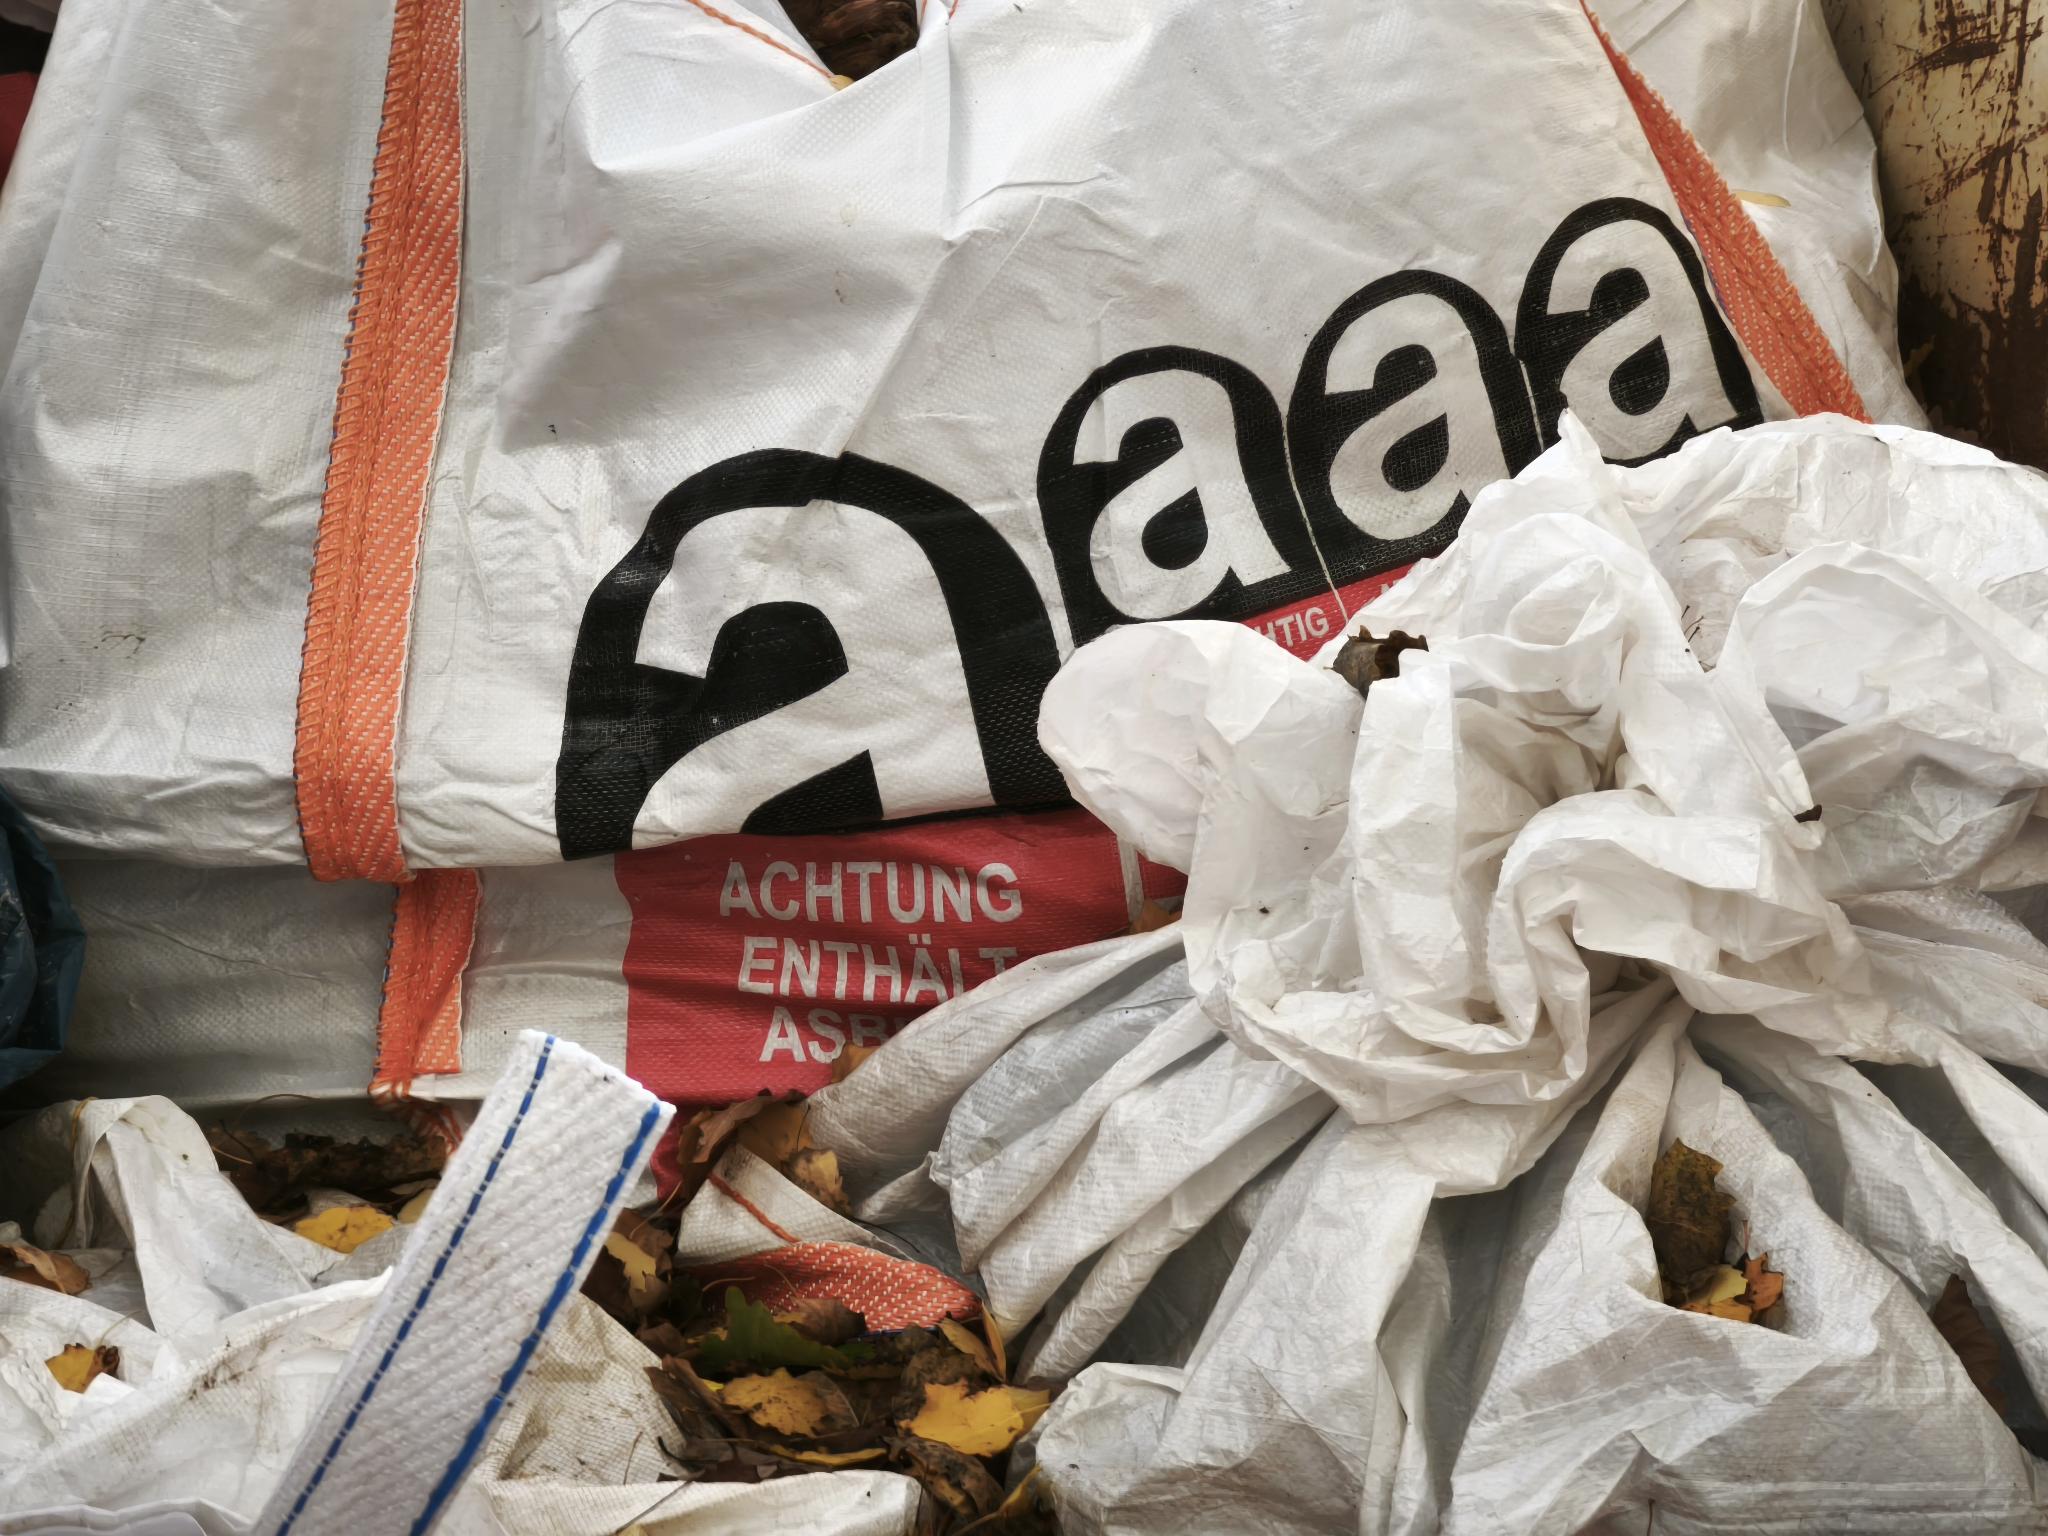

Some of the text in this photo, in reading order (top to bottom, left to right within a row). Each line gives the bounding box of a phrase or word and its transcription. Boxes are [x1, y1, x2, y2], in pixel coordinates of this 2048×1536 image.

[1072, 368, 1290, 620] a
[1325, 293, 1510, 540] a
[1547, 220, 1740, 459] a
[720, 861, 1023, 922] ACHTUNG
[738, 933, 1018, 1003] ENTHÄLT
[759, 1006, 908, 1064] ASB
